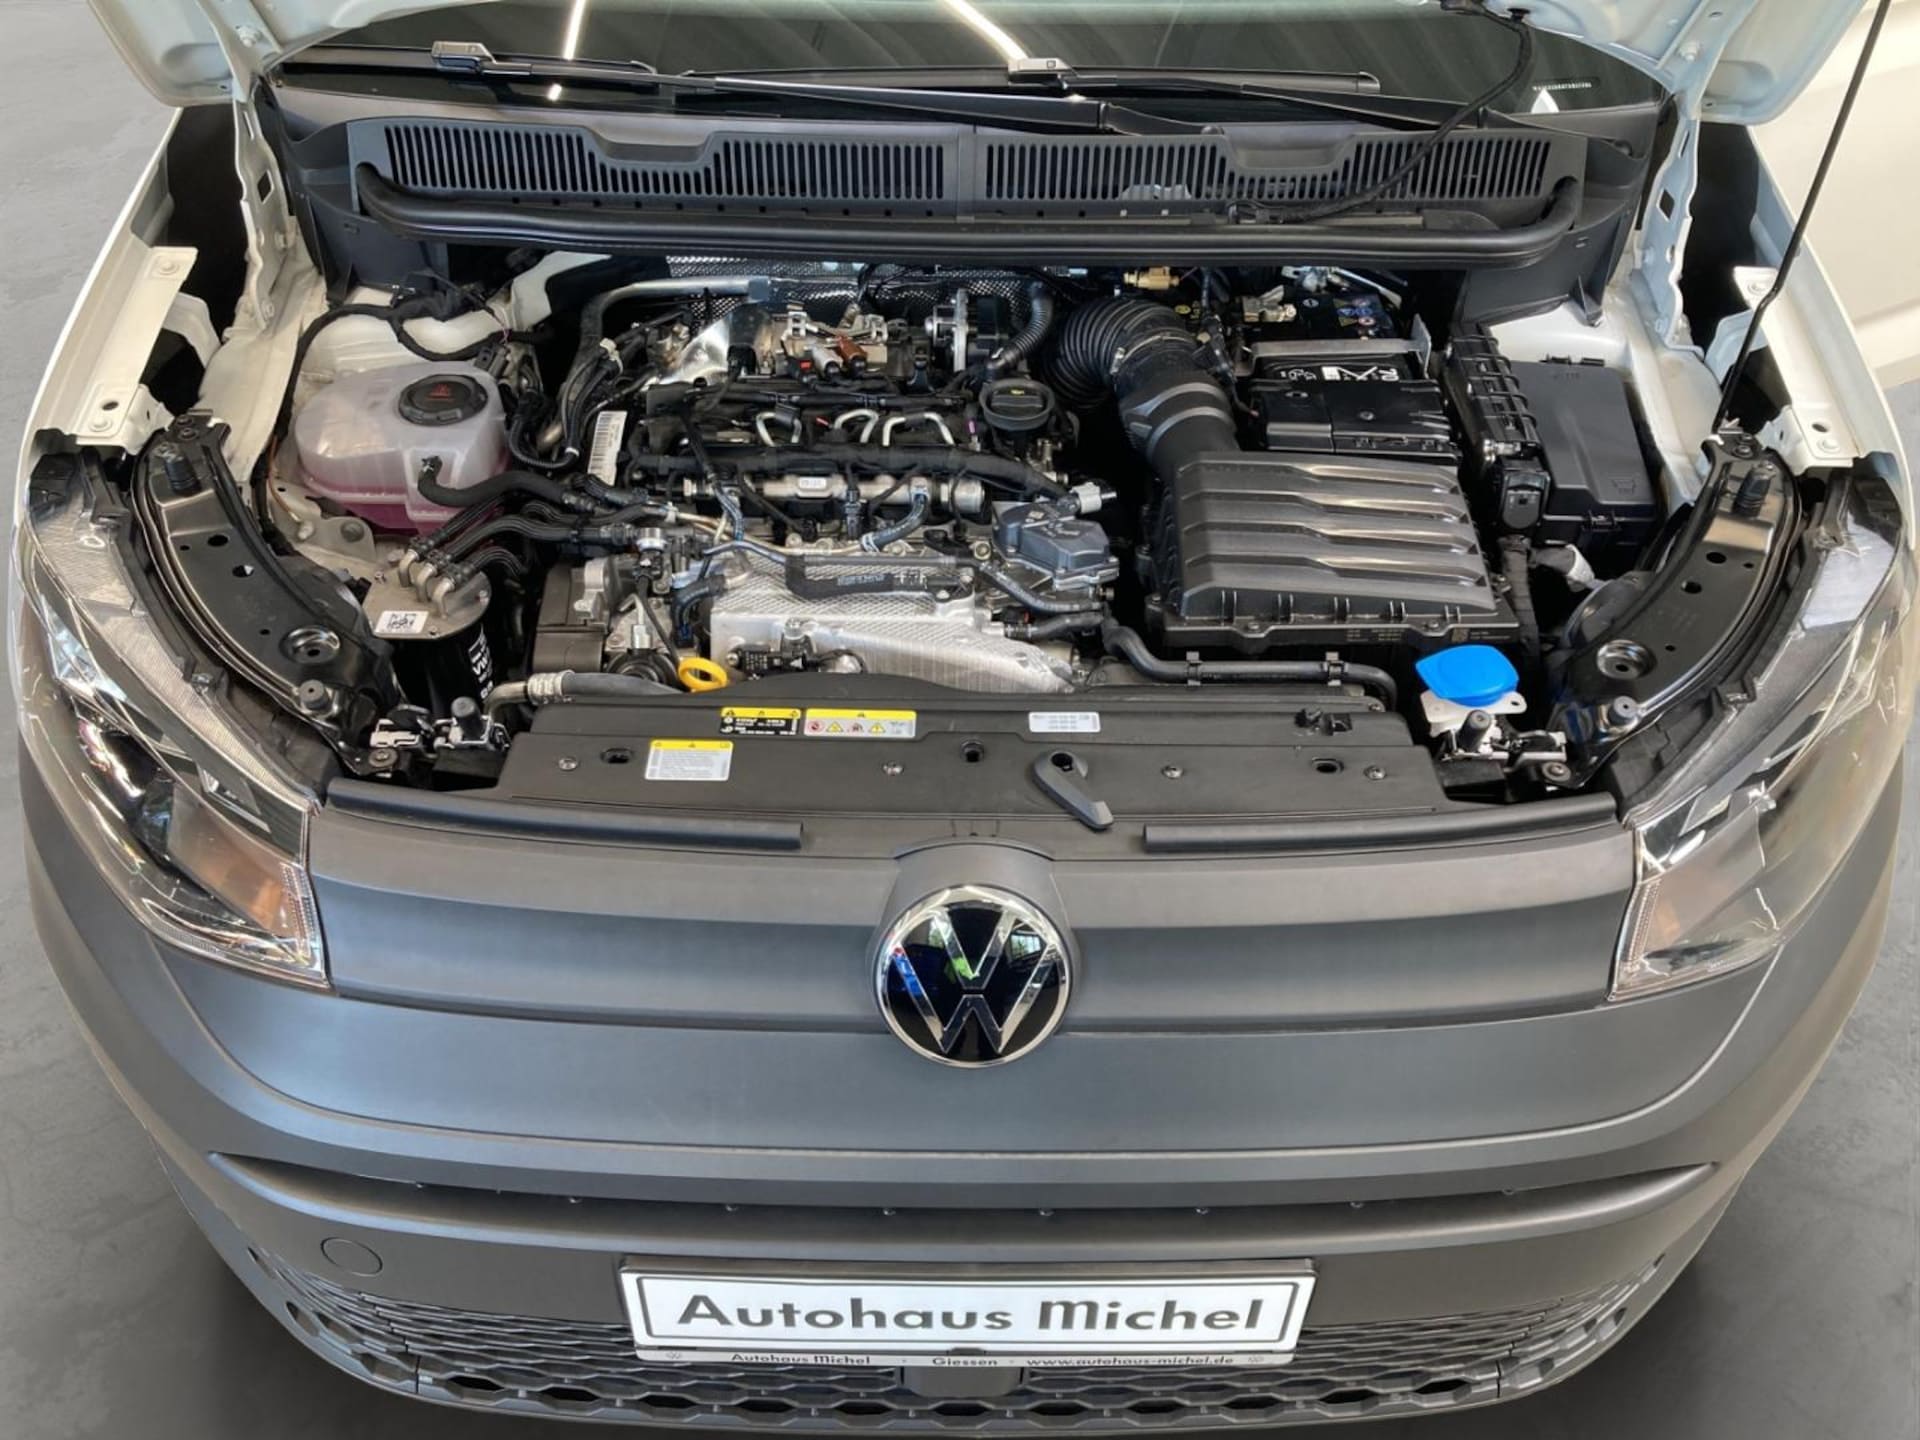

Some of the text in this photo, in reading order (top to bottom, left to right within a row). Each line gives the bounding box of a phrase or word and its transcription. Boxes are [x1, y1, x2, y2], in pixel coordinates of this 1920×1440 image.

[677, 1294, 1264, 1330] Autohaus Michel
[731, 1353, 1235, 1366] Autohaus Michel Giessen www.autohaus-michel.de
